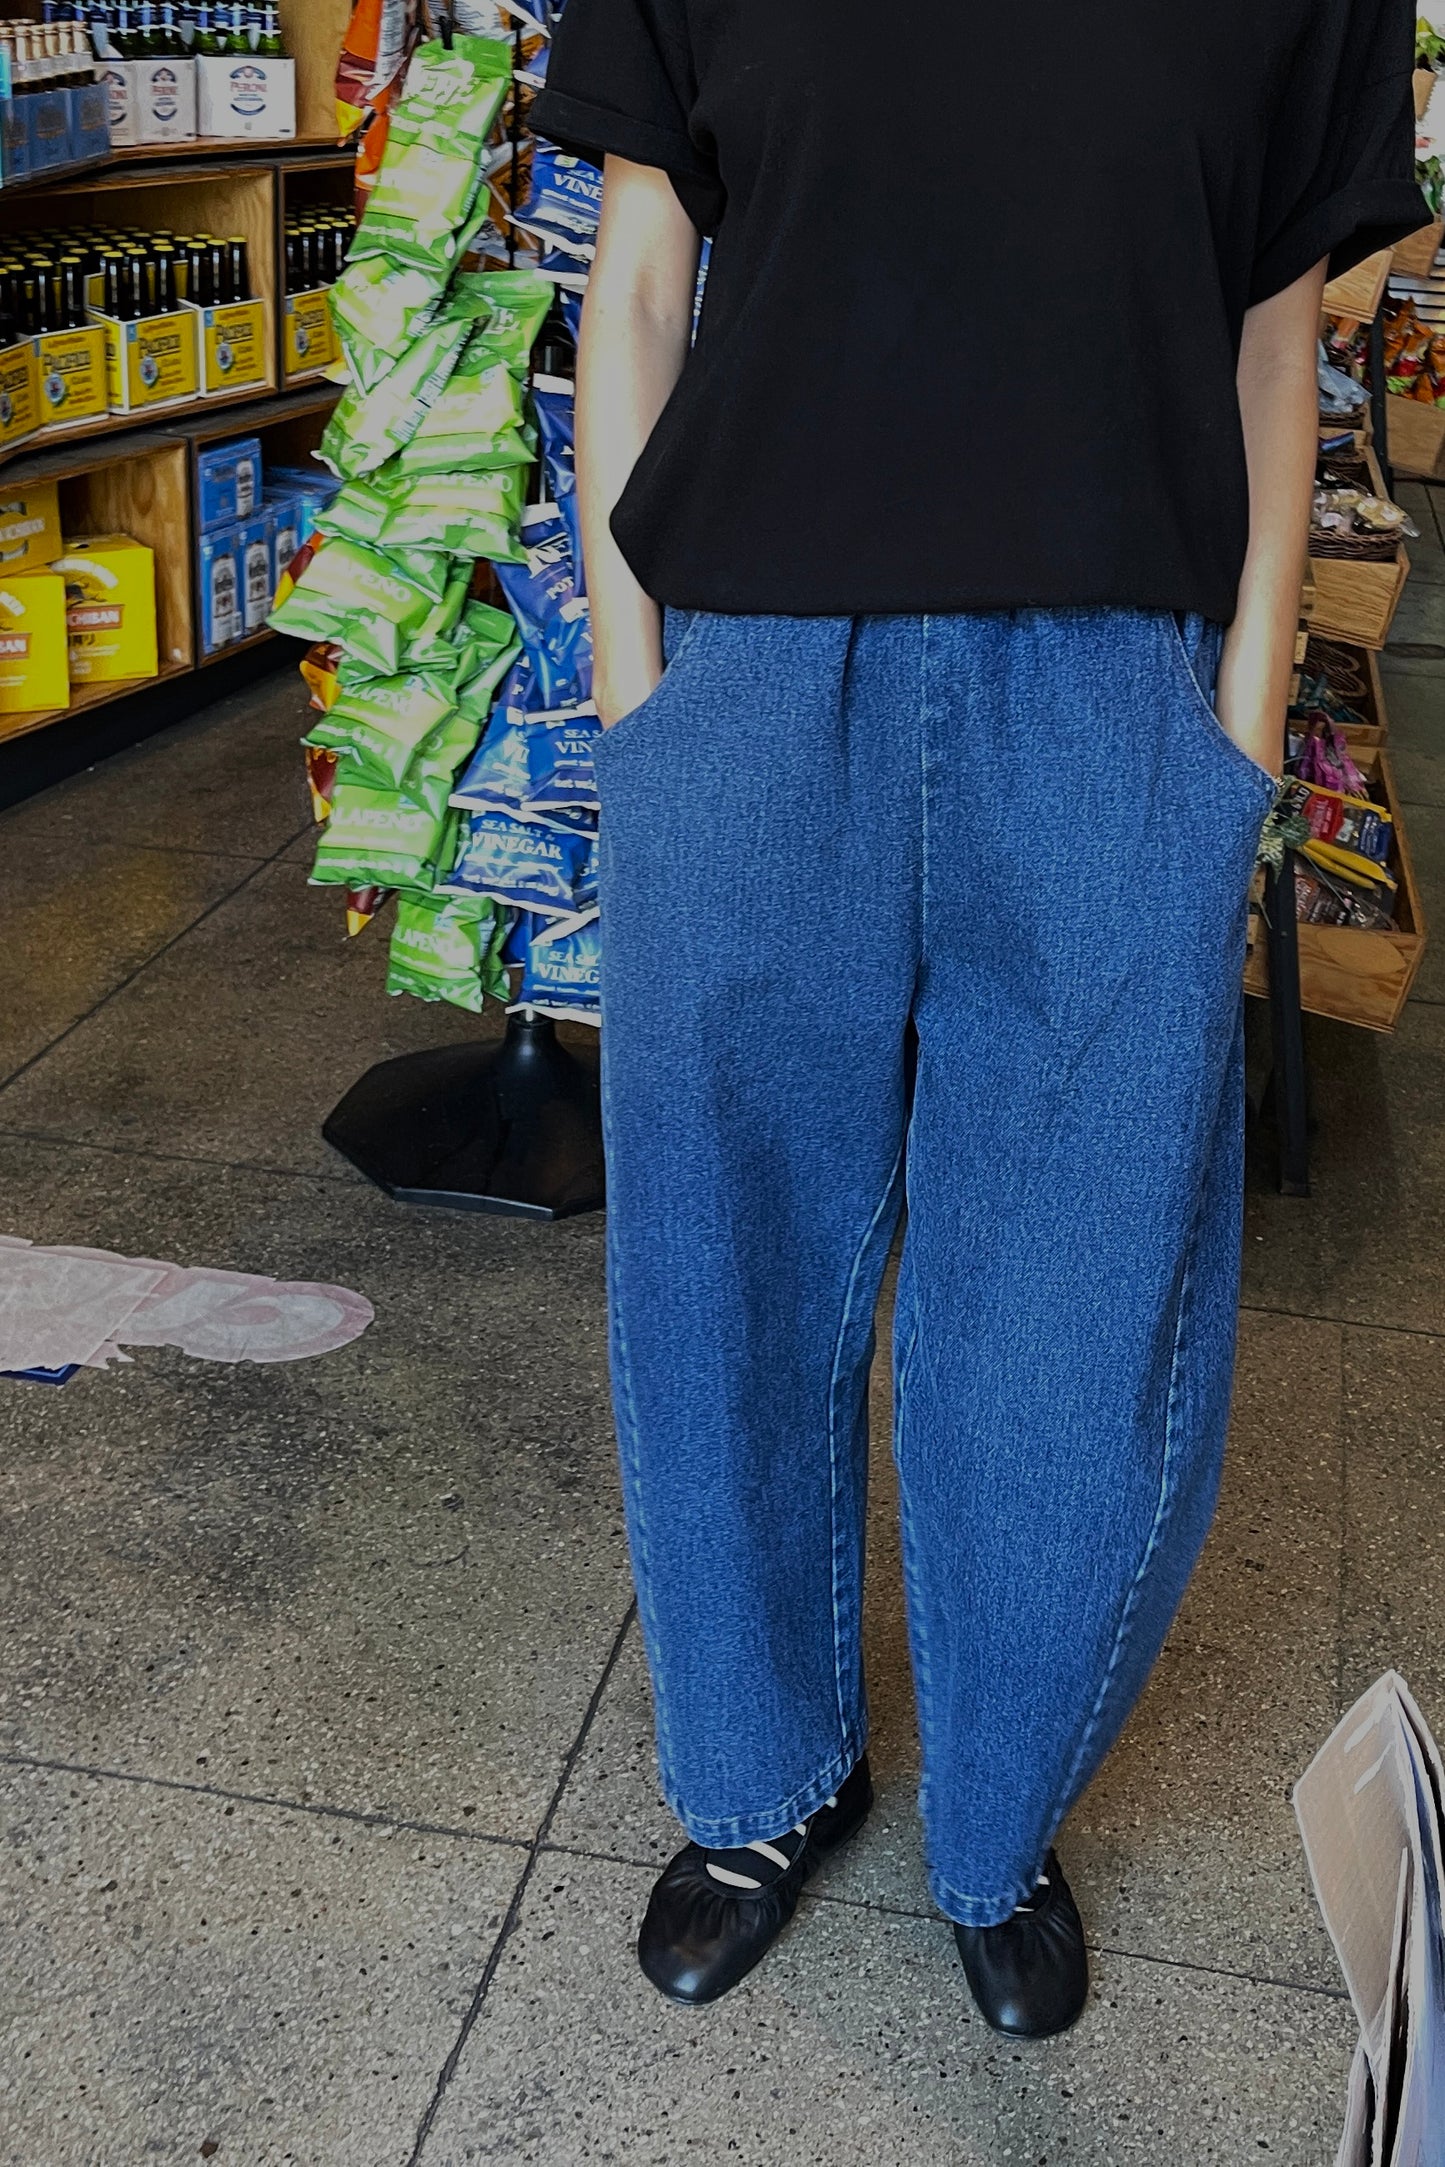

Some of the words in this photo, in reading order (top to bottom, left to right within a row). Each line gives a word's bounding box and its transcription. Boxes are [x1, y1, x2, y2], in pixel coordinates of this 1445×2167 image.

[563, 729, 592, 739] SEA
[481, 819, 507, 832] SEA
[472, 831, 564, 860] VINEGAR
[537, 962, 600, 984] VINEG
